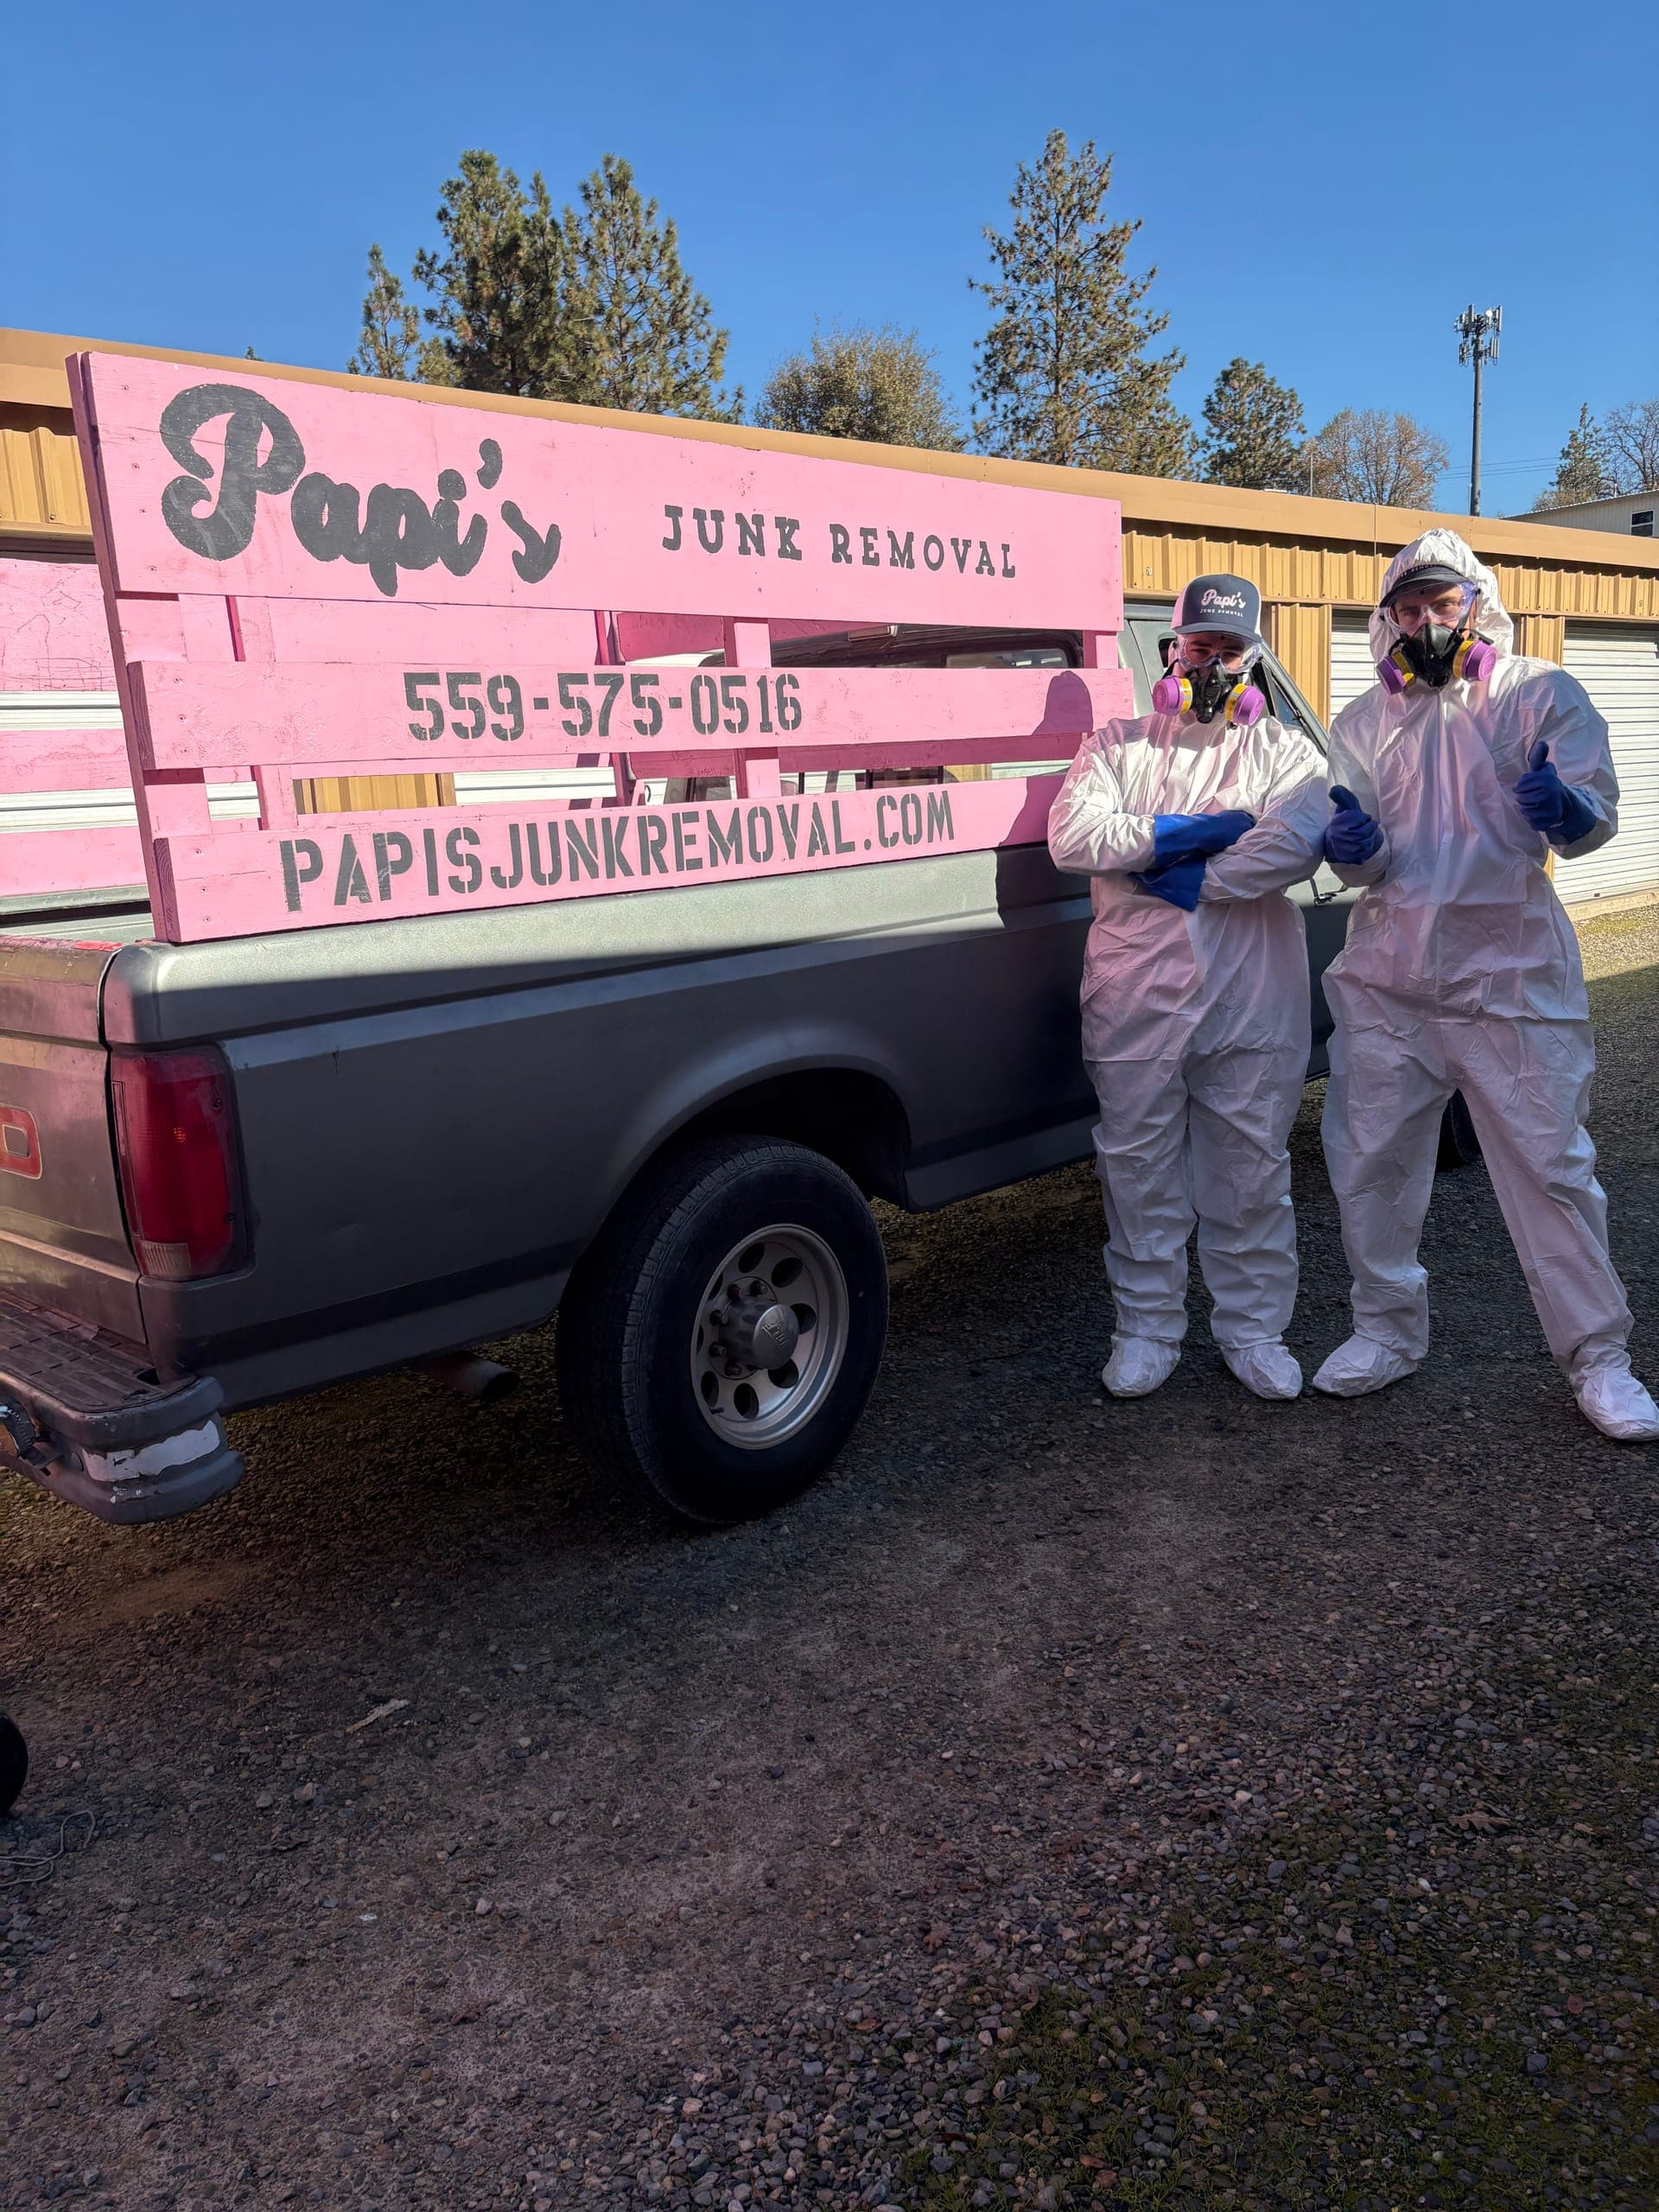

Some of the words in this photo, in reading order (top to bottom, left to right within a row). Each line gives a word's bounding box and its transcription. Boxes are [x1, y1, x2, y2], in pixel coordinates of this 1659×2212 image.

[160, 384, 562, 596] Papi's
[662, 505, 802, 561] JUNK
[829, 524, 1016, 578] REMOVAL
[1201, 588, 1246, 608] Papi's
[404, 672, 802, 741] 559-575-0516
[281, 791, 955, 912] PAPISJUNKREMOVAL.COM
